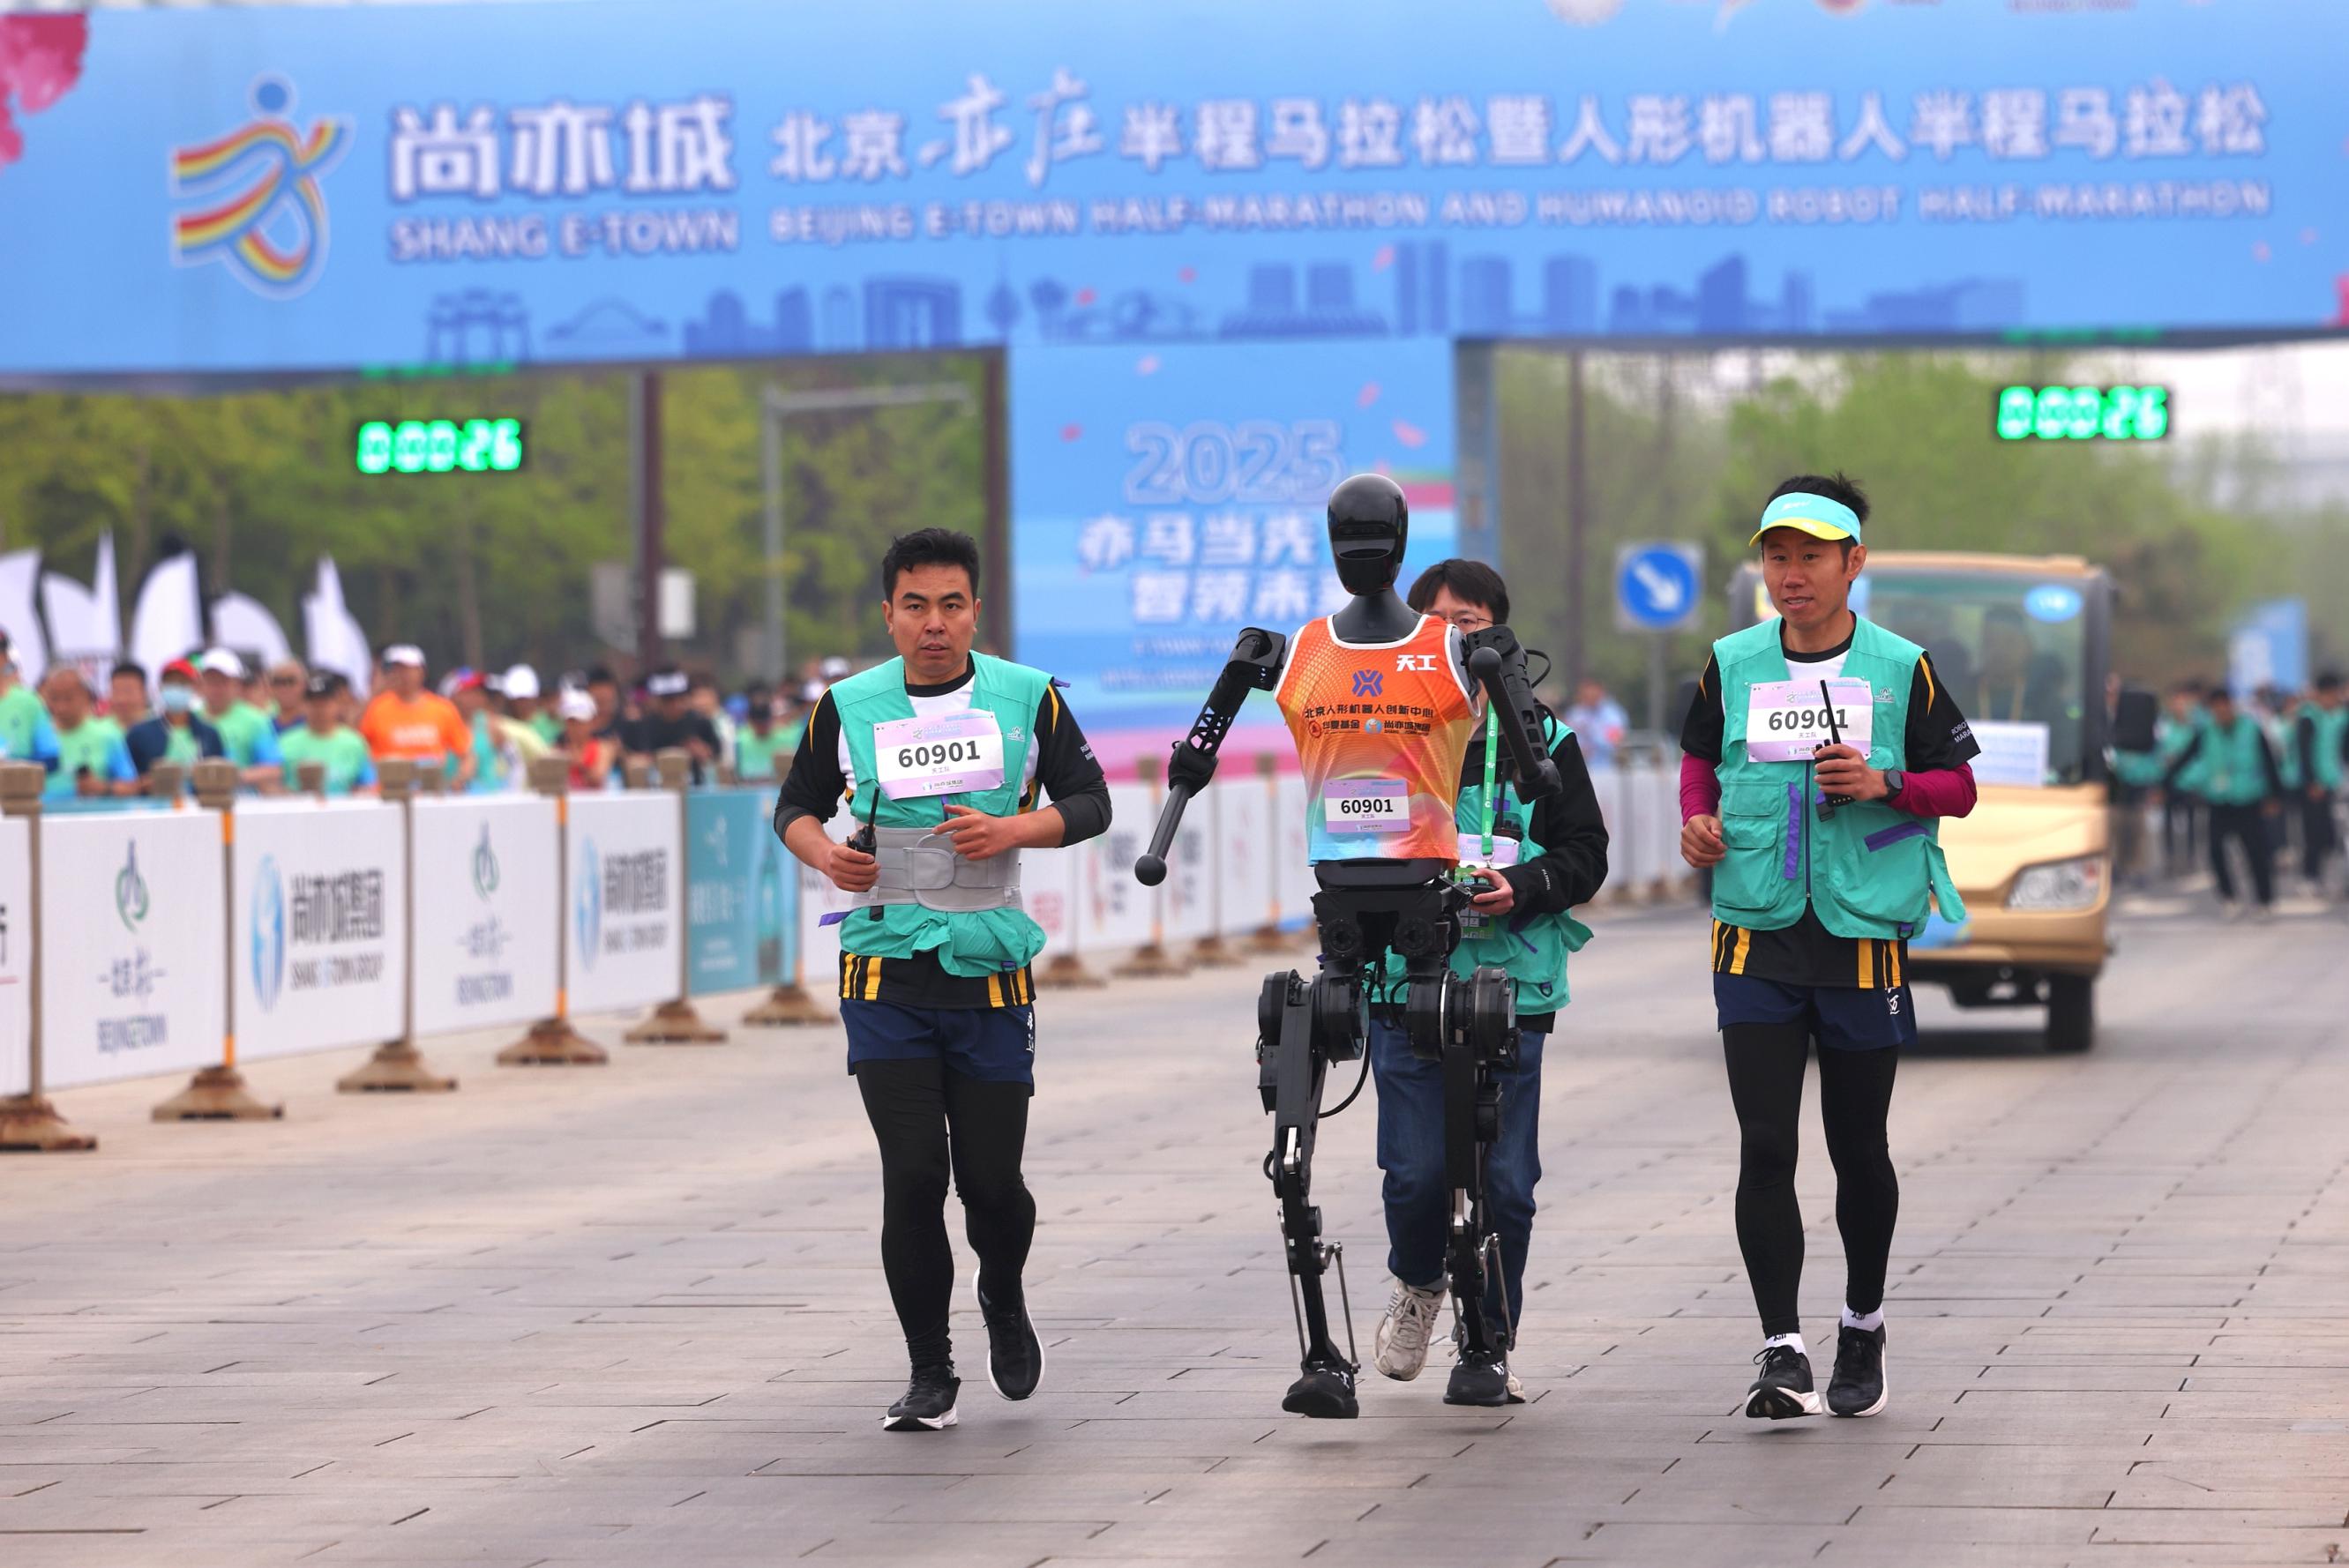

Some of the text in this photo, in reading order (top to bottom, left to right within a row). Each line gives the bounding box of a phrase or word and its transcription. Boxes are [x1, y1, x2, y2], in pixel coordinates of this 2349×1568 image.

[390, 94, 737, 200] 尚亦城
[771, 182, 2270, 243] BEIJING E-TOWN HALF-MARATHON AND HUMANOID ROBOT HALF-MARATHON
[391, 209, 739, 260] SHANG E-TOWN
[1125, 419, 1343, 505] 2025
[1396, 654, 1438, 671] 天工
[1305, 705, 1433, 719] 北京人形机器人创新中心
[1769, 709, 1849, 730] 60901
[898, 740, 981, 768] 60901
[1340, 798, 1394, 814] 60901
